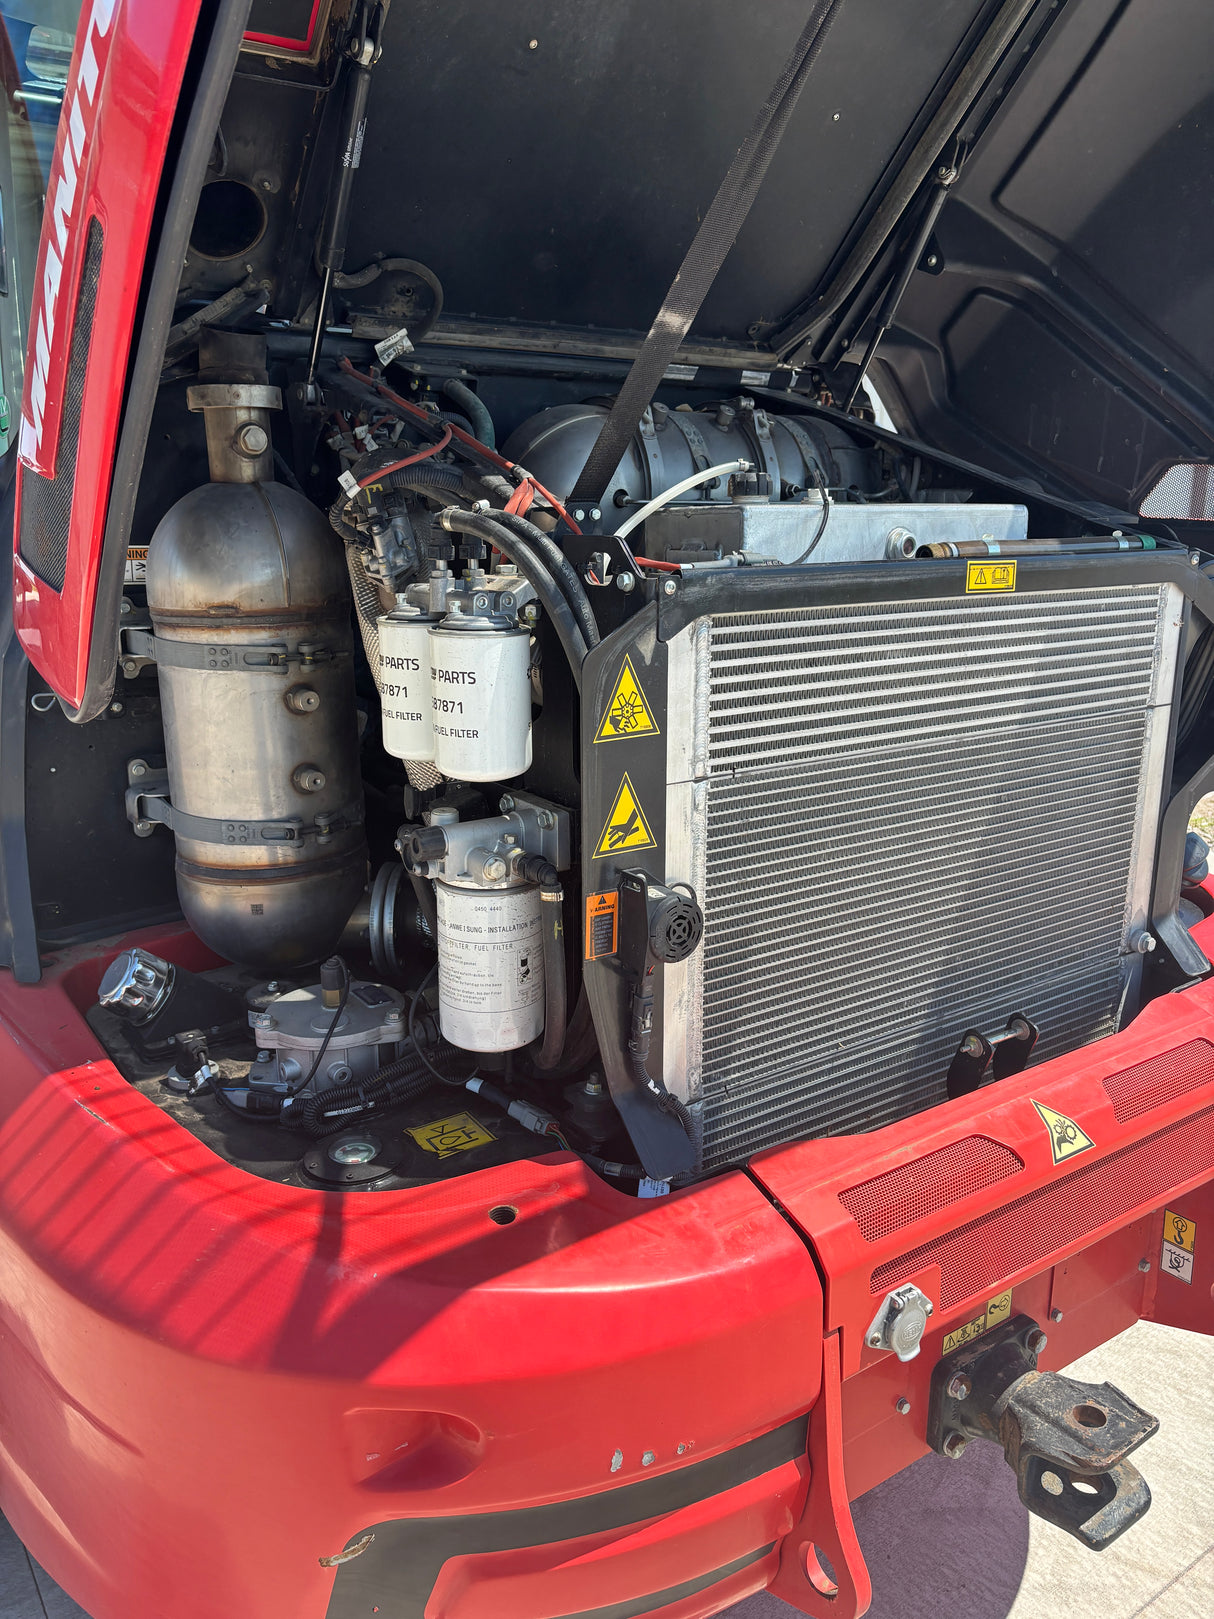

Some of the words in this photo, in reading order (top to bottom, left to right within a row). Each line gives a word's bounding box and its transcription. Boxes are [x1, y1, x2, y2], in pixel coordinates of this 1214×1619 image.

[385, 656, 420, 671] PARTS
[438, 669, 476, 685] PARTS
[396, 711, 423, 721] FILTER
[450, 728, 479, 739] FILTER
[488, 923, 528, 934] INSTALLATION
[493, 943, 514, 952] FILTER
